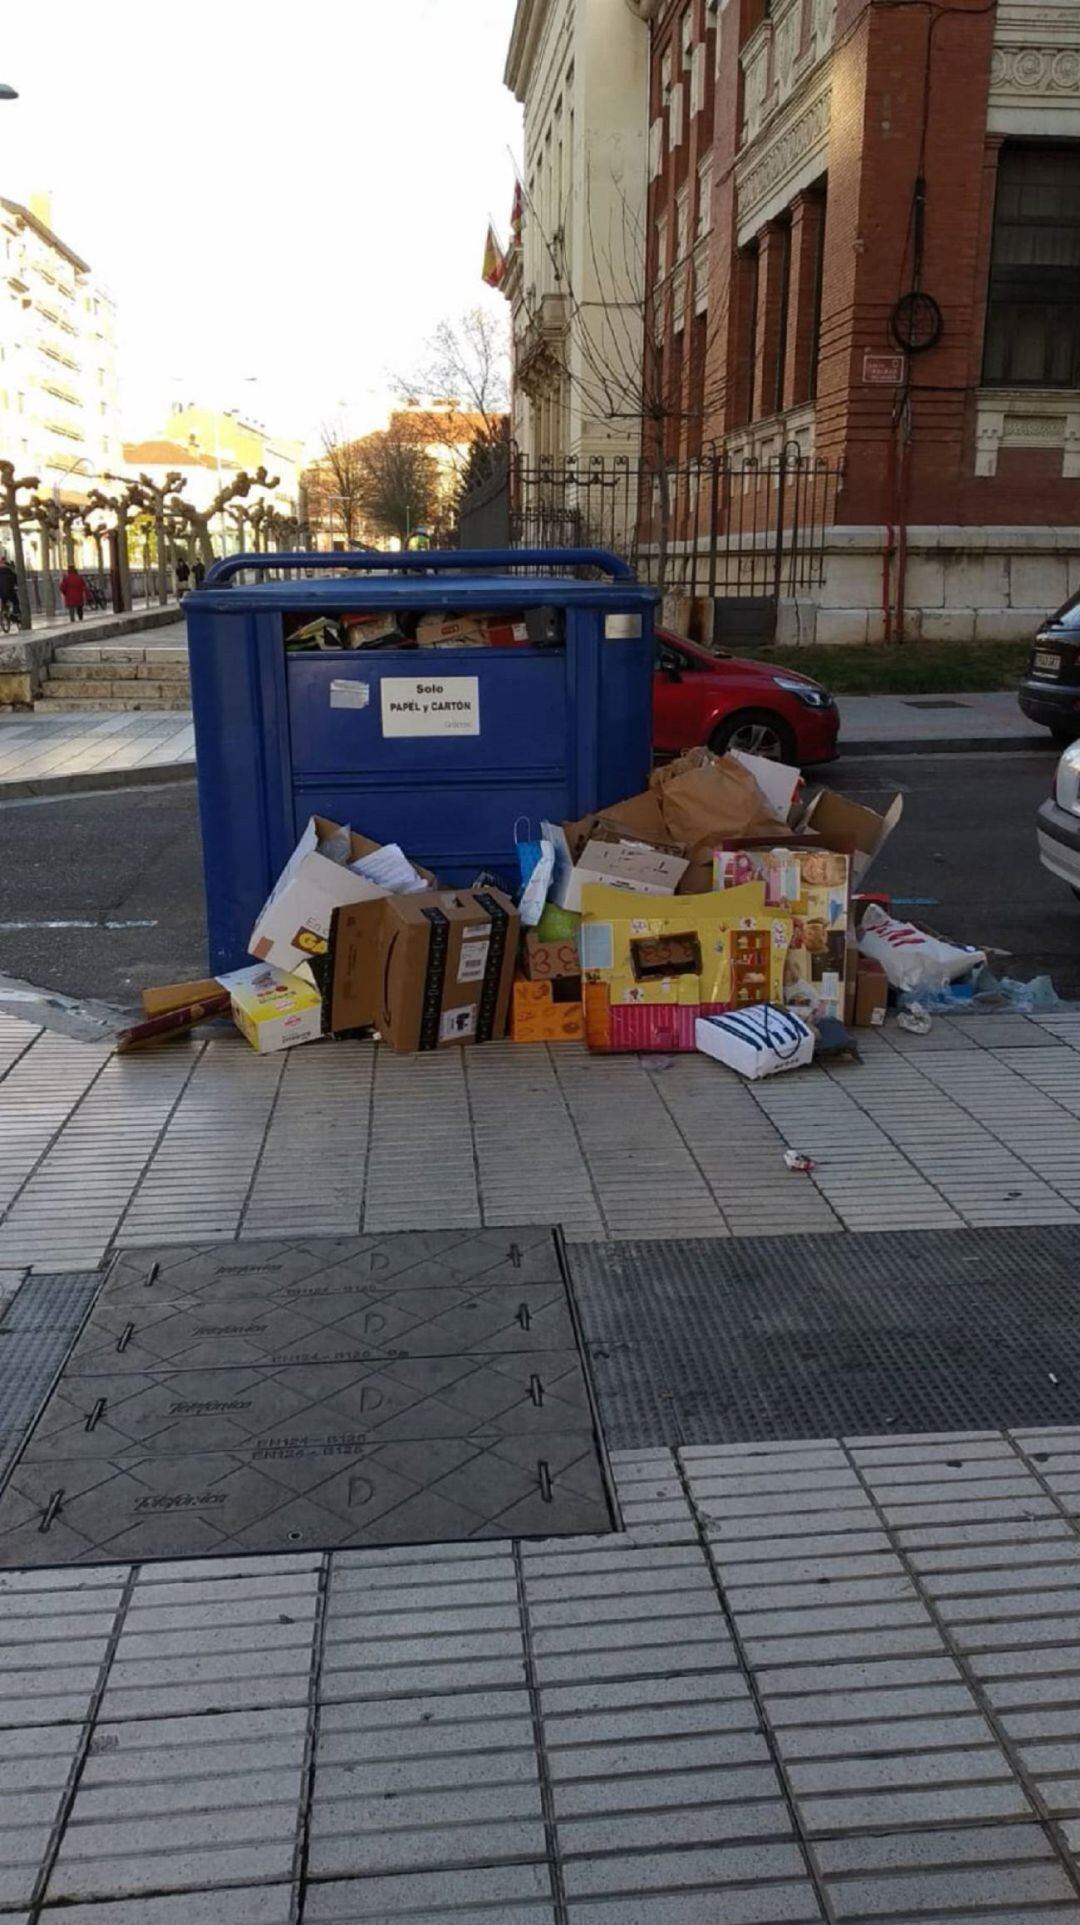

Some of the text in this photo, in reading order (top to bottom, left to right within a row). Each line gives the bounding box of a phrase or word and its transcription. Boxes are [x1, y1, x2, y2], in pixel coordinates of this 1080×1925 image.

[416, 684, 444, 694] Solo
[423, 704, 429, 713] y
[370, 1252, 390, 1271] D
[364, 1313, 385, 1333] D
[360, 1386, 383, 1413] D
[347, 1476, 374, 1507] D
